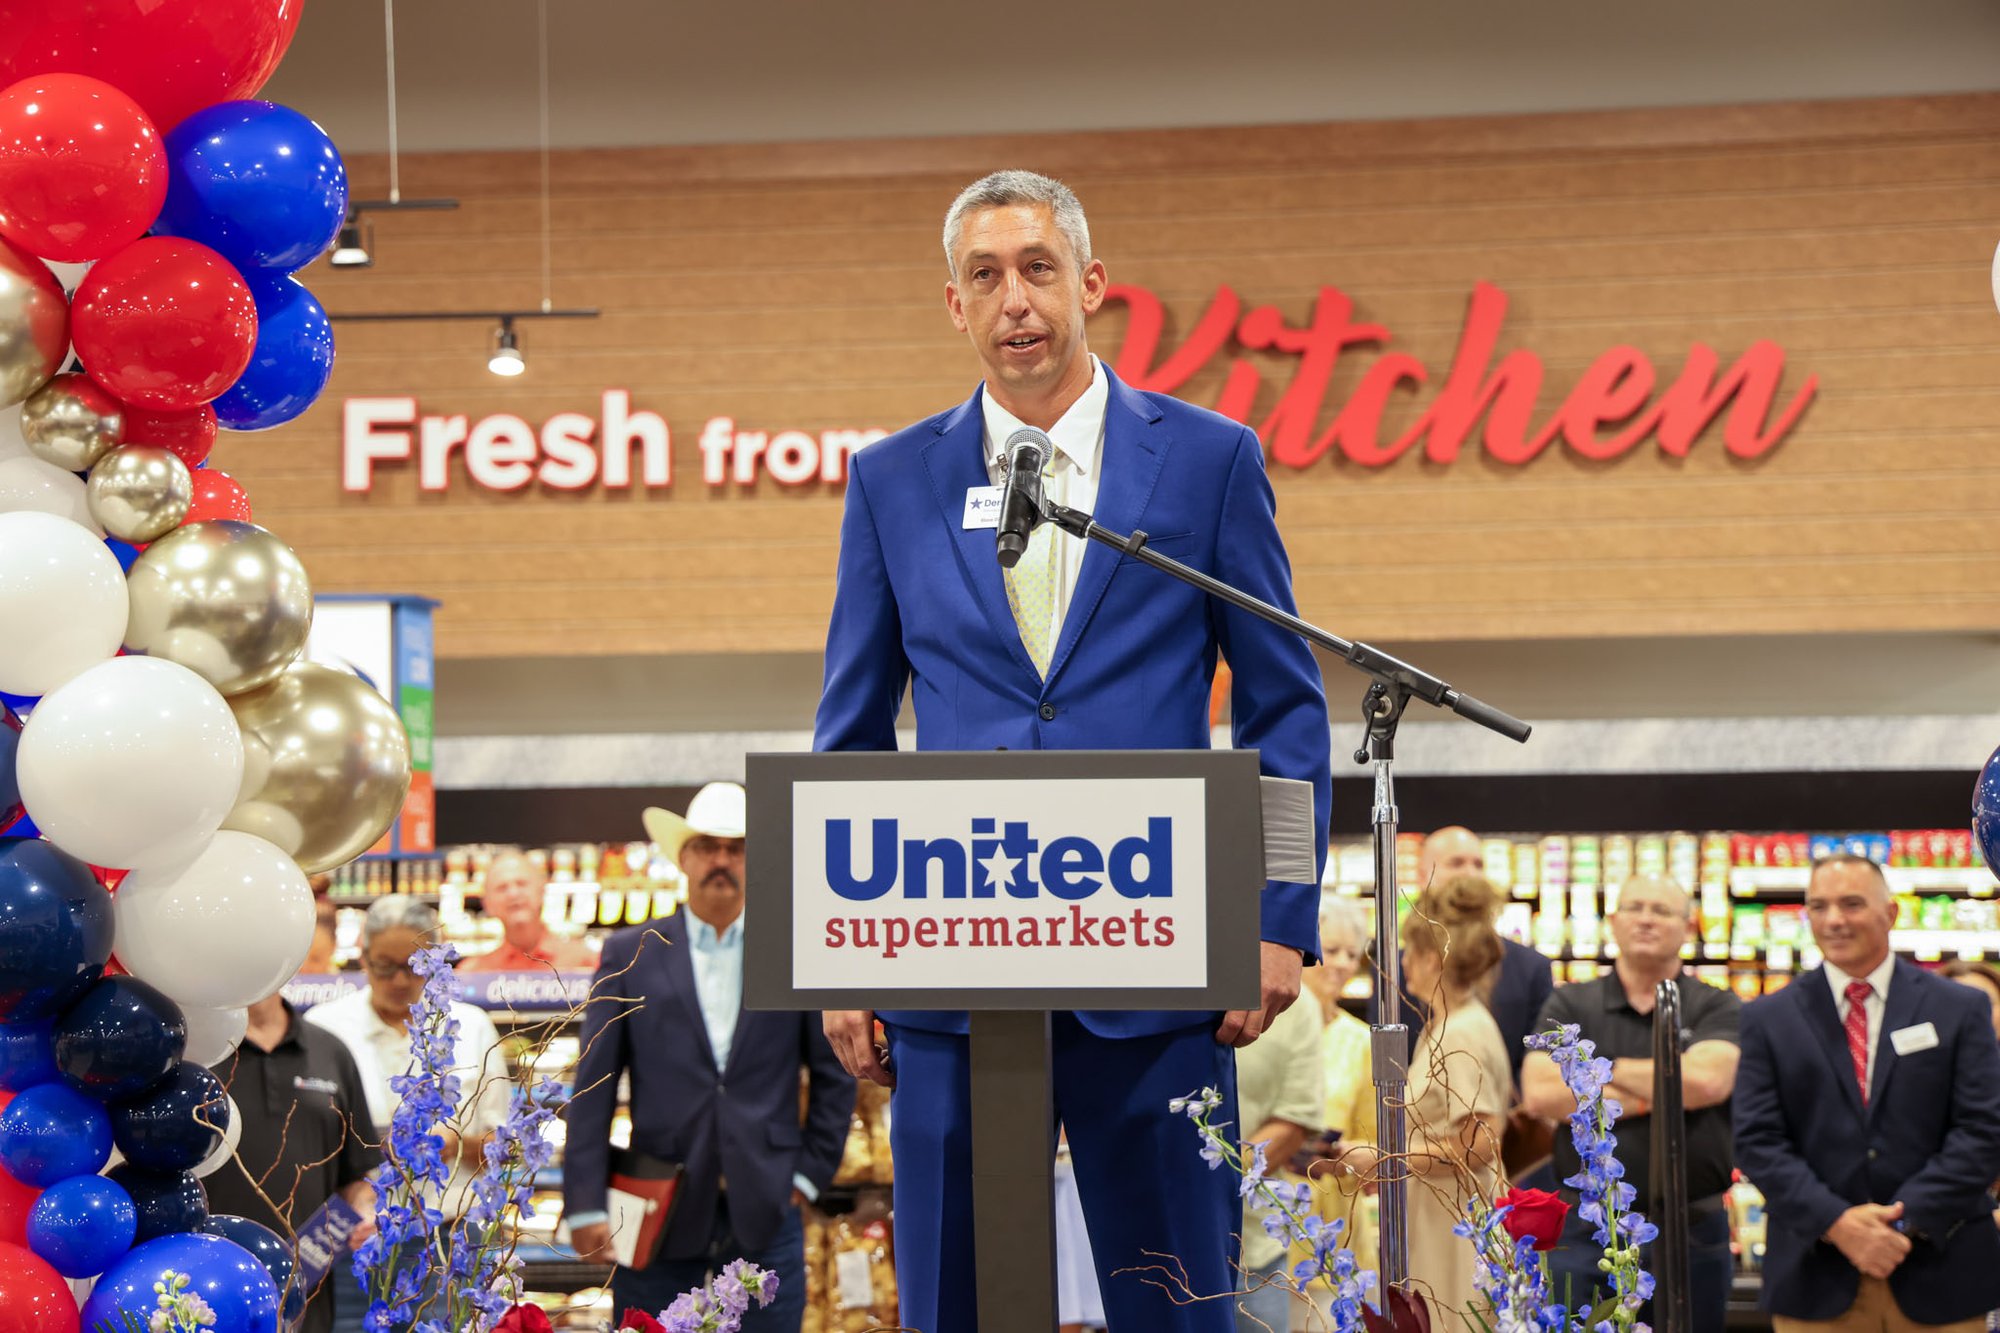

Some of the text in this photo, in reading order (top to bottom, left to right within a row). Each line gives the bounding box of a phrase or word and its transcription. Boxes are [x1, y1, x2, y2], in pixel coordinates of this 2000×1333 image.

[343, 389, 671, 491] Fresh
[1104, 281, 1818, 467] Kitchen
[984, 499, 1003, 507] Der
[825, 817, 1173, 901] United
[825, 905, 1175, 958] supermarkets
[486, 974, 592, 1003] delicious
